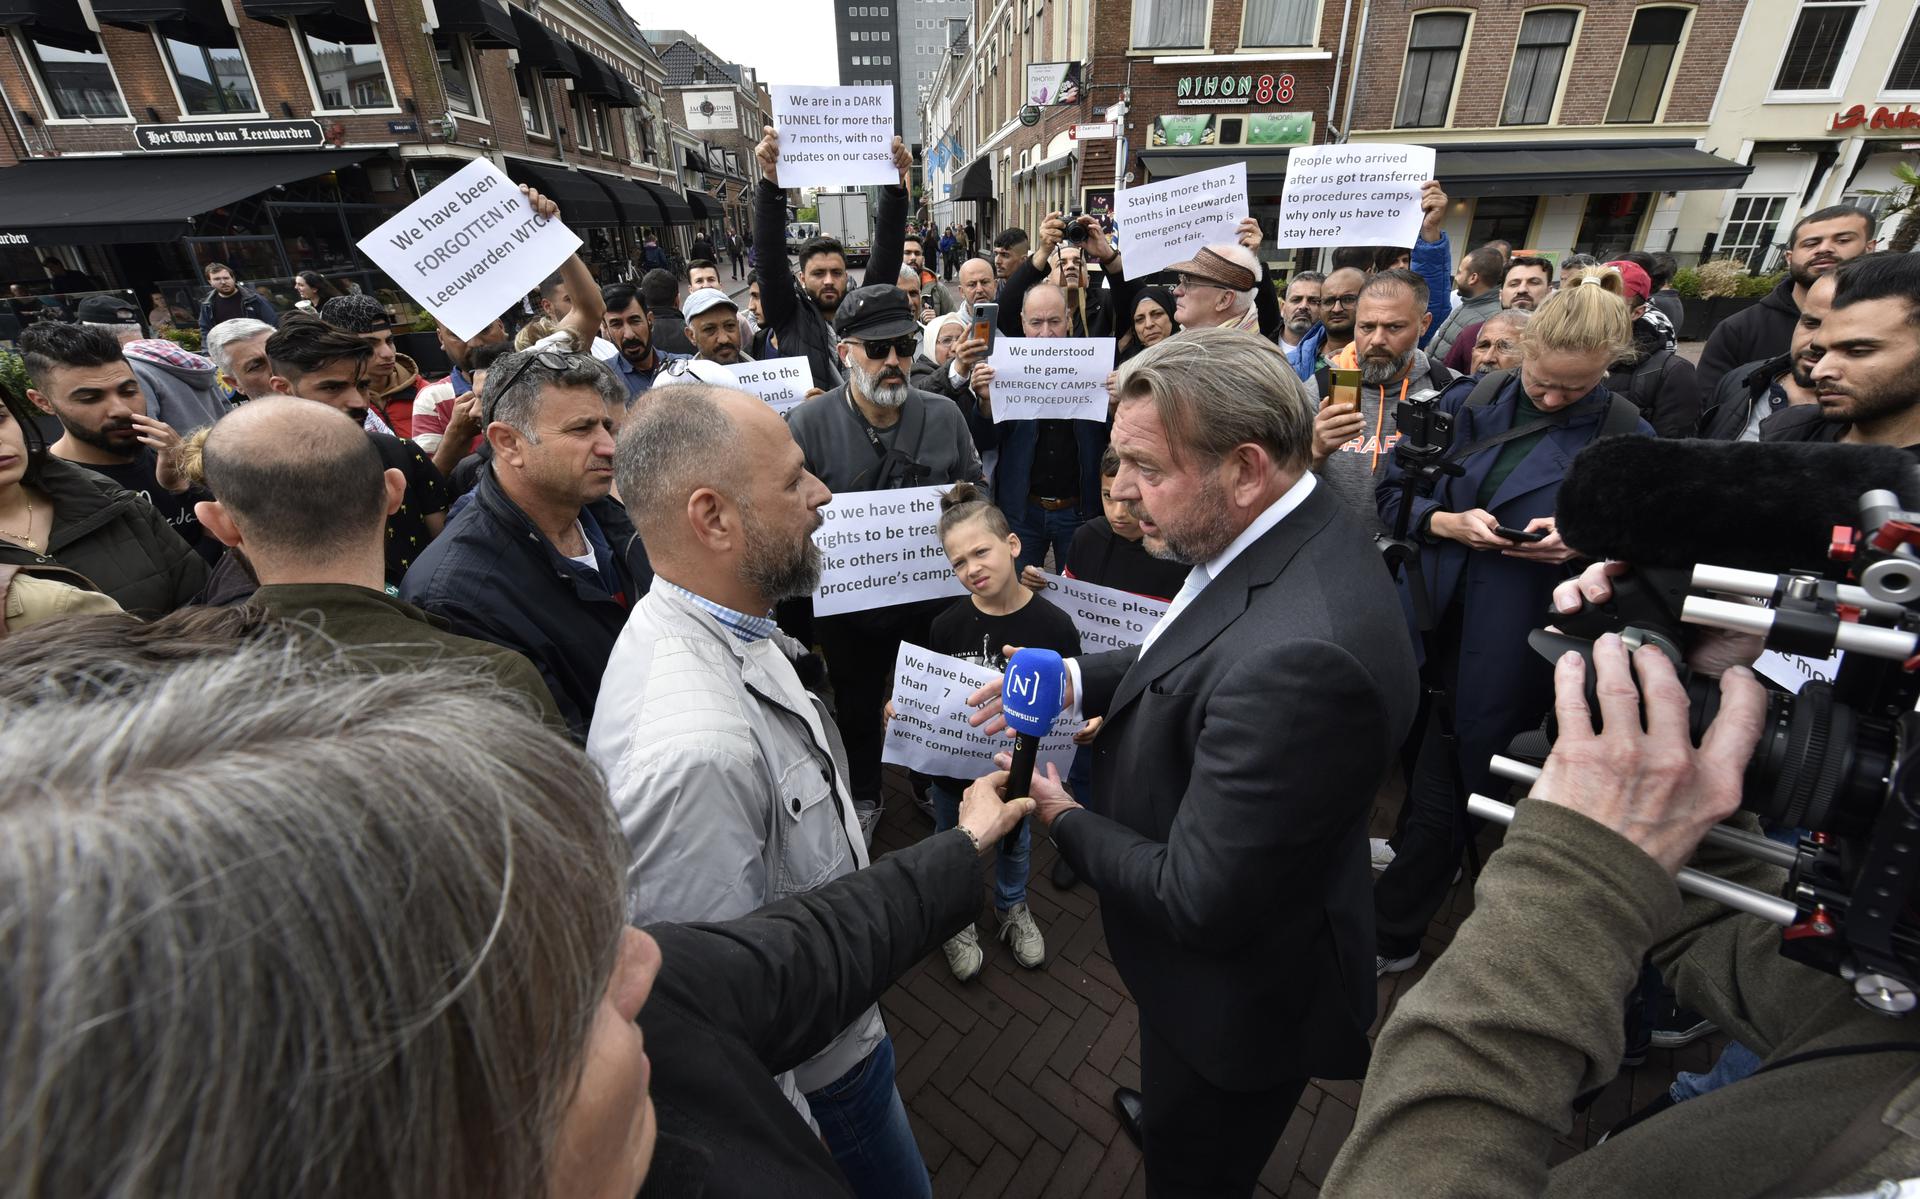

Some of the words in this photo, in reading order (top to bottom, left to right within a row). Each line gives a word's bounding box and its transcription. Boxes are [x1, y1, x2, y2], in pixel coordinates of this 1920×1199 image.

[1178, 75, 1252, 97] NIHON
[1256, 74, 1295, 104] 88
[790, 95, 808, 106] We
[811, 97, 829, 106] are
[832, 95, 841, 106] in
[844, 98, 851, 106] a
[853, 96, 882, 106] DARK
[777, 115, 821, 125] TUNNEL
[824, 115, 839, 125] for
[842, 117, 869, 125] more
[871, 115, 892, 125] than
[145, 131, 170, 146] Het
[170, 130, 214, 144] Wapen
[216, 130, 238, 142] van
[239, 127, 312, 141] Leeuwarden
[790, 133, 797, 143] 7
[800, 133, 842, 144] months,
[845, 133, 867, 143] with
[870, 135, 883, 143] no
[783, 152, 825, 164] updates
[827, 153, 840, 162] on
[843, 153, 860, 161] our
[862, 152, 892, 161] cases.
[1293, 155, 1332, 168] People
[1336, 154, 1361, 165] who
[1365, 153, 1408, 164] arrived
[1290, 174, 1318, 185] after
[1321, 175, 1334, 184] us
[1336, 173, 1357, 185] got
[1359, 170, 1428, 182] transferred
[1128, 190, 1168, 208] Staying
[1170, 184, 1199, 199] more
[1202, 178, 1227, 191] than
[1229, 174, 1236, 184] 2
[1288, 194, 1300, 203] to
[1302, 191, 1368, 204] procedures
[1371, 192, 1413, 202] camps,
[390, 226, 424, 251] We
[419, 200, 461, 232] have
[455, 174, 498, 205] been
[1123, 210, 1164, 226] months
[1166, 207, 1176, 217] in
[1179, 192, 1244, 214] Leeuwarden
[1286, 210, 1309, 222] why
[1312, 208, 1337, 221] only
[1340, 210, 1352, 219] us
[1356, 208, 1384, 218] have
[1388, 208, 1400, 218] to
[1135, 219, 1192, 241] emergency
[1194, 214, 1223, 226] camp
[1226, 211, 1234, 221] is
[1284, 228, 1307, 240] stay
[1309, 225, 1341, 237] here?
[0, 231, 29, 244] arden
[414, 206, 505, 277] FORGOTTEN
[500, 196, 520, 214] in
[1164, 238, 1182, 248] not
[1184, 232, 1205, 243] fair.
[426, 240, 516, 309] Leeuwarden
[510, 213, 550, 244] WTC.
[1009, 346, 1028, 356] We
[1031, 346, 1095, 357] understood
[762, 371, 776, 381] to
[780, 366, 800, 379] the
[1024, 365, 1042, 375] the
[1044, 367, 1078, 377] game,
[995, 380, 1058, 390] EMERGENCY
[1061, 381, 1097, 390] CAMPS
[760, 387, 794, 402] lands
[1006, 395, 1021, 404] NO
[1024, 395, 1093, 405] PROCEDURES.
[840, 508, 864, 519] we
[869, 503, 906, 517] have
[910, 498, 934, 513] the
[816, 531, 861, 548] rights
[865, 530, 881, 542] to
[886, 526, 904, 540] be
[908, 524, 938, 537] trea
[822, 557, 845, 571] ike
[850, 552, 898, 567] others
[903, 548, 916, 561] in
[920, 544, 944, 558] the
[1063, 585, 1117, 608] Justice
[1122, 602, 1167, 618] pleas
[1077, 608, 1121, 627] come
[1125, 620, 1143, 632] to
[1080, 630, 1136, 649] warden
[905, 655, 924, 670] We
[927, 663, 957, 681] have
[959, 673, 985, 690] bee
[901, 675, 928, 692] than
[943, 687, 951, 698] 7
[898, 695, 940, 715] arrived
[950, 711, 969, 724] aft
[893, 728, 923, 744] were
[895, 712, 935, 733] camps,
[939, 726, 963, 740] and
[966, 732, 997, 746] their
